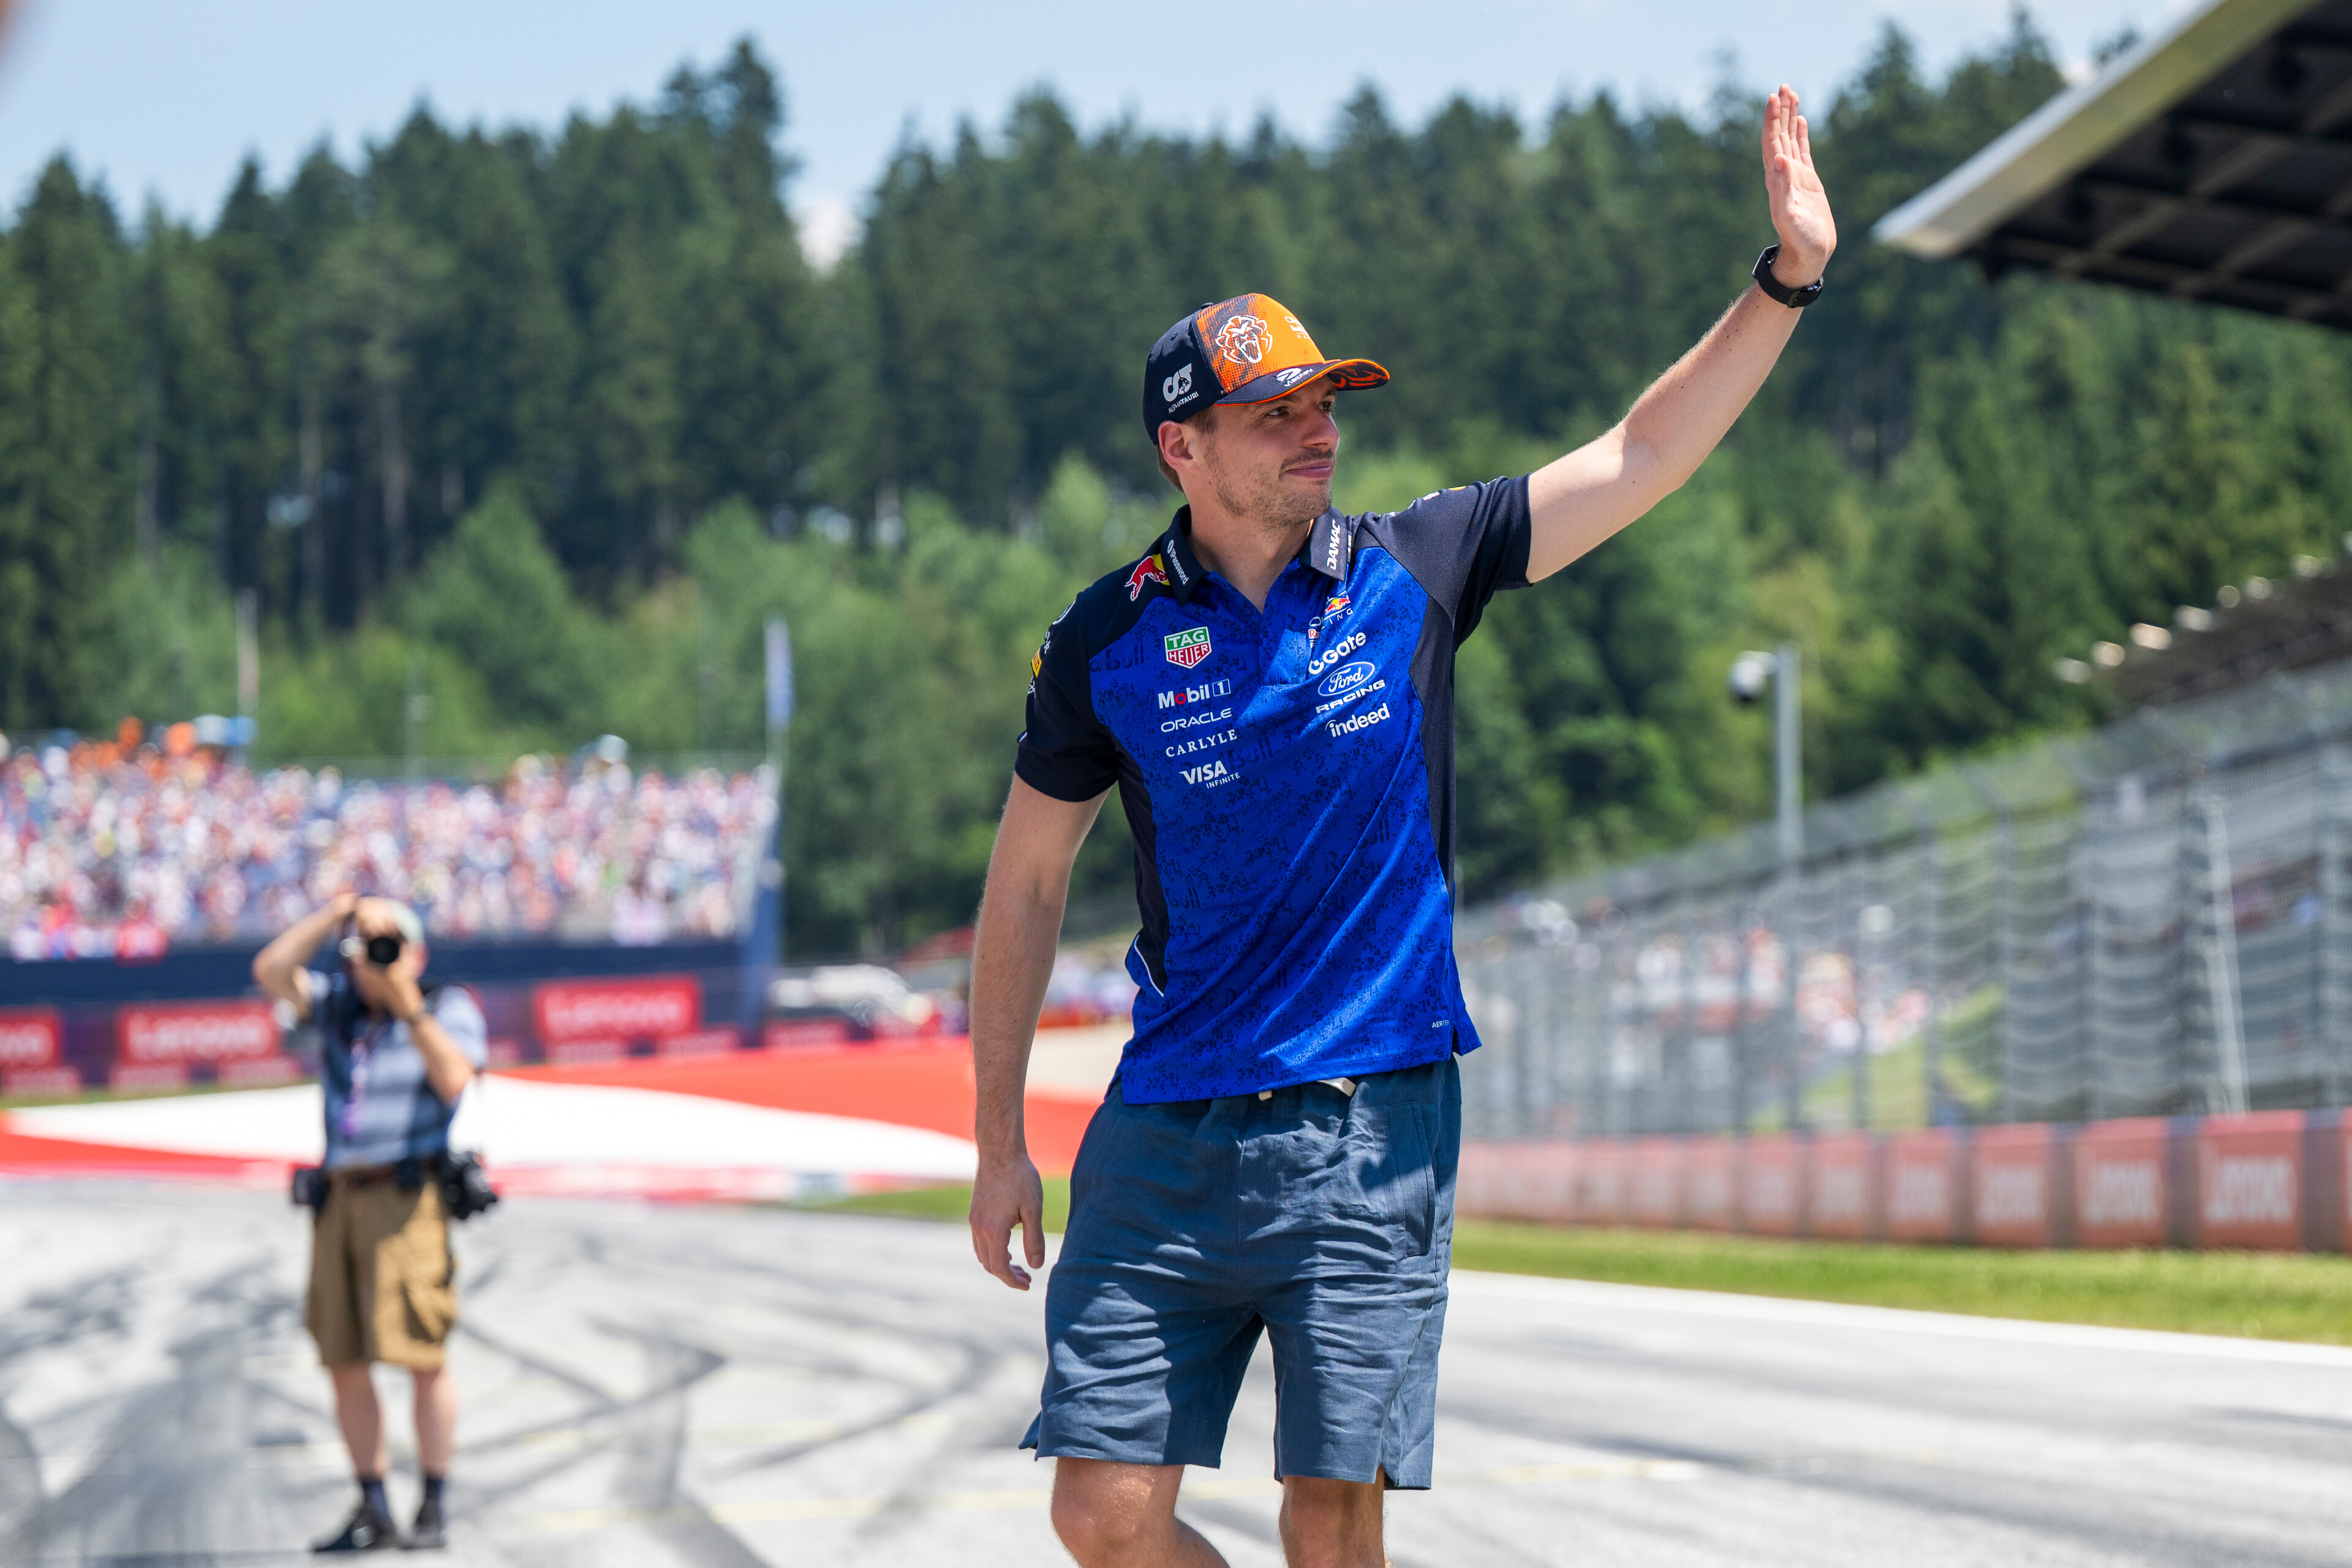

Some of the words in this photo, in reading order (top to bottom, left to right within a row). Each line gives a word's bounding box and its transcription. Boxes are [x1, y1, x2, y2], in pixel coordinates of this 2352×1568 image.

[1168, 391, 1199, 414] ALPHATAURI
[1327, 519, 1341, 570] DAMAC
[1169, 630, 1205, 648] TAG
[1169, 644, 1208, 666] HEUER
[1329, 667, 1363, 693] Ford
[1158, 684, 1210, 709] Mobil
[1316, 679, 1385, 714] RACING
[1161, 707, 1232, 733] ORACLE
[1329, 703, 1390, 737] indeed
[1166, 729, 1237, 757] CARLYLE
[1179, 760, 1227, 785] VISA
[1205, 772, 1240, 789] INFINITE
